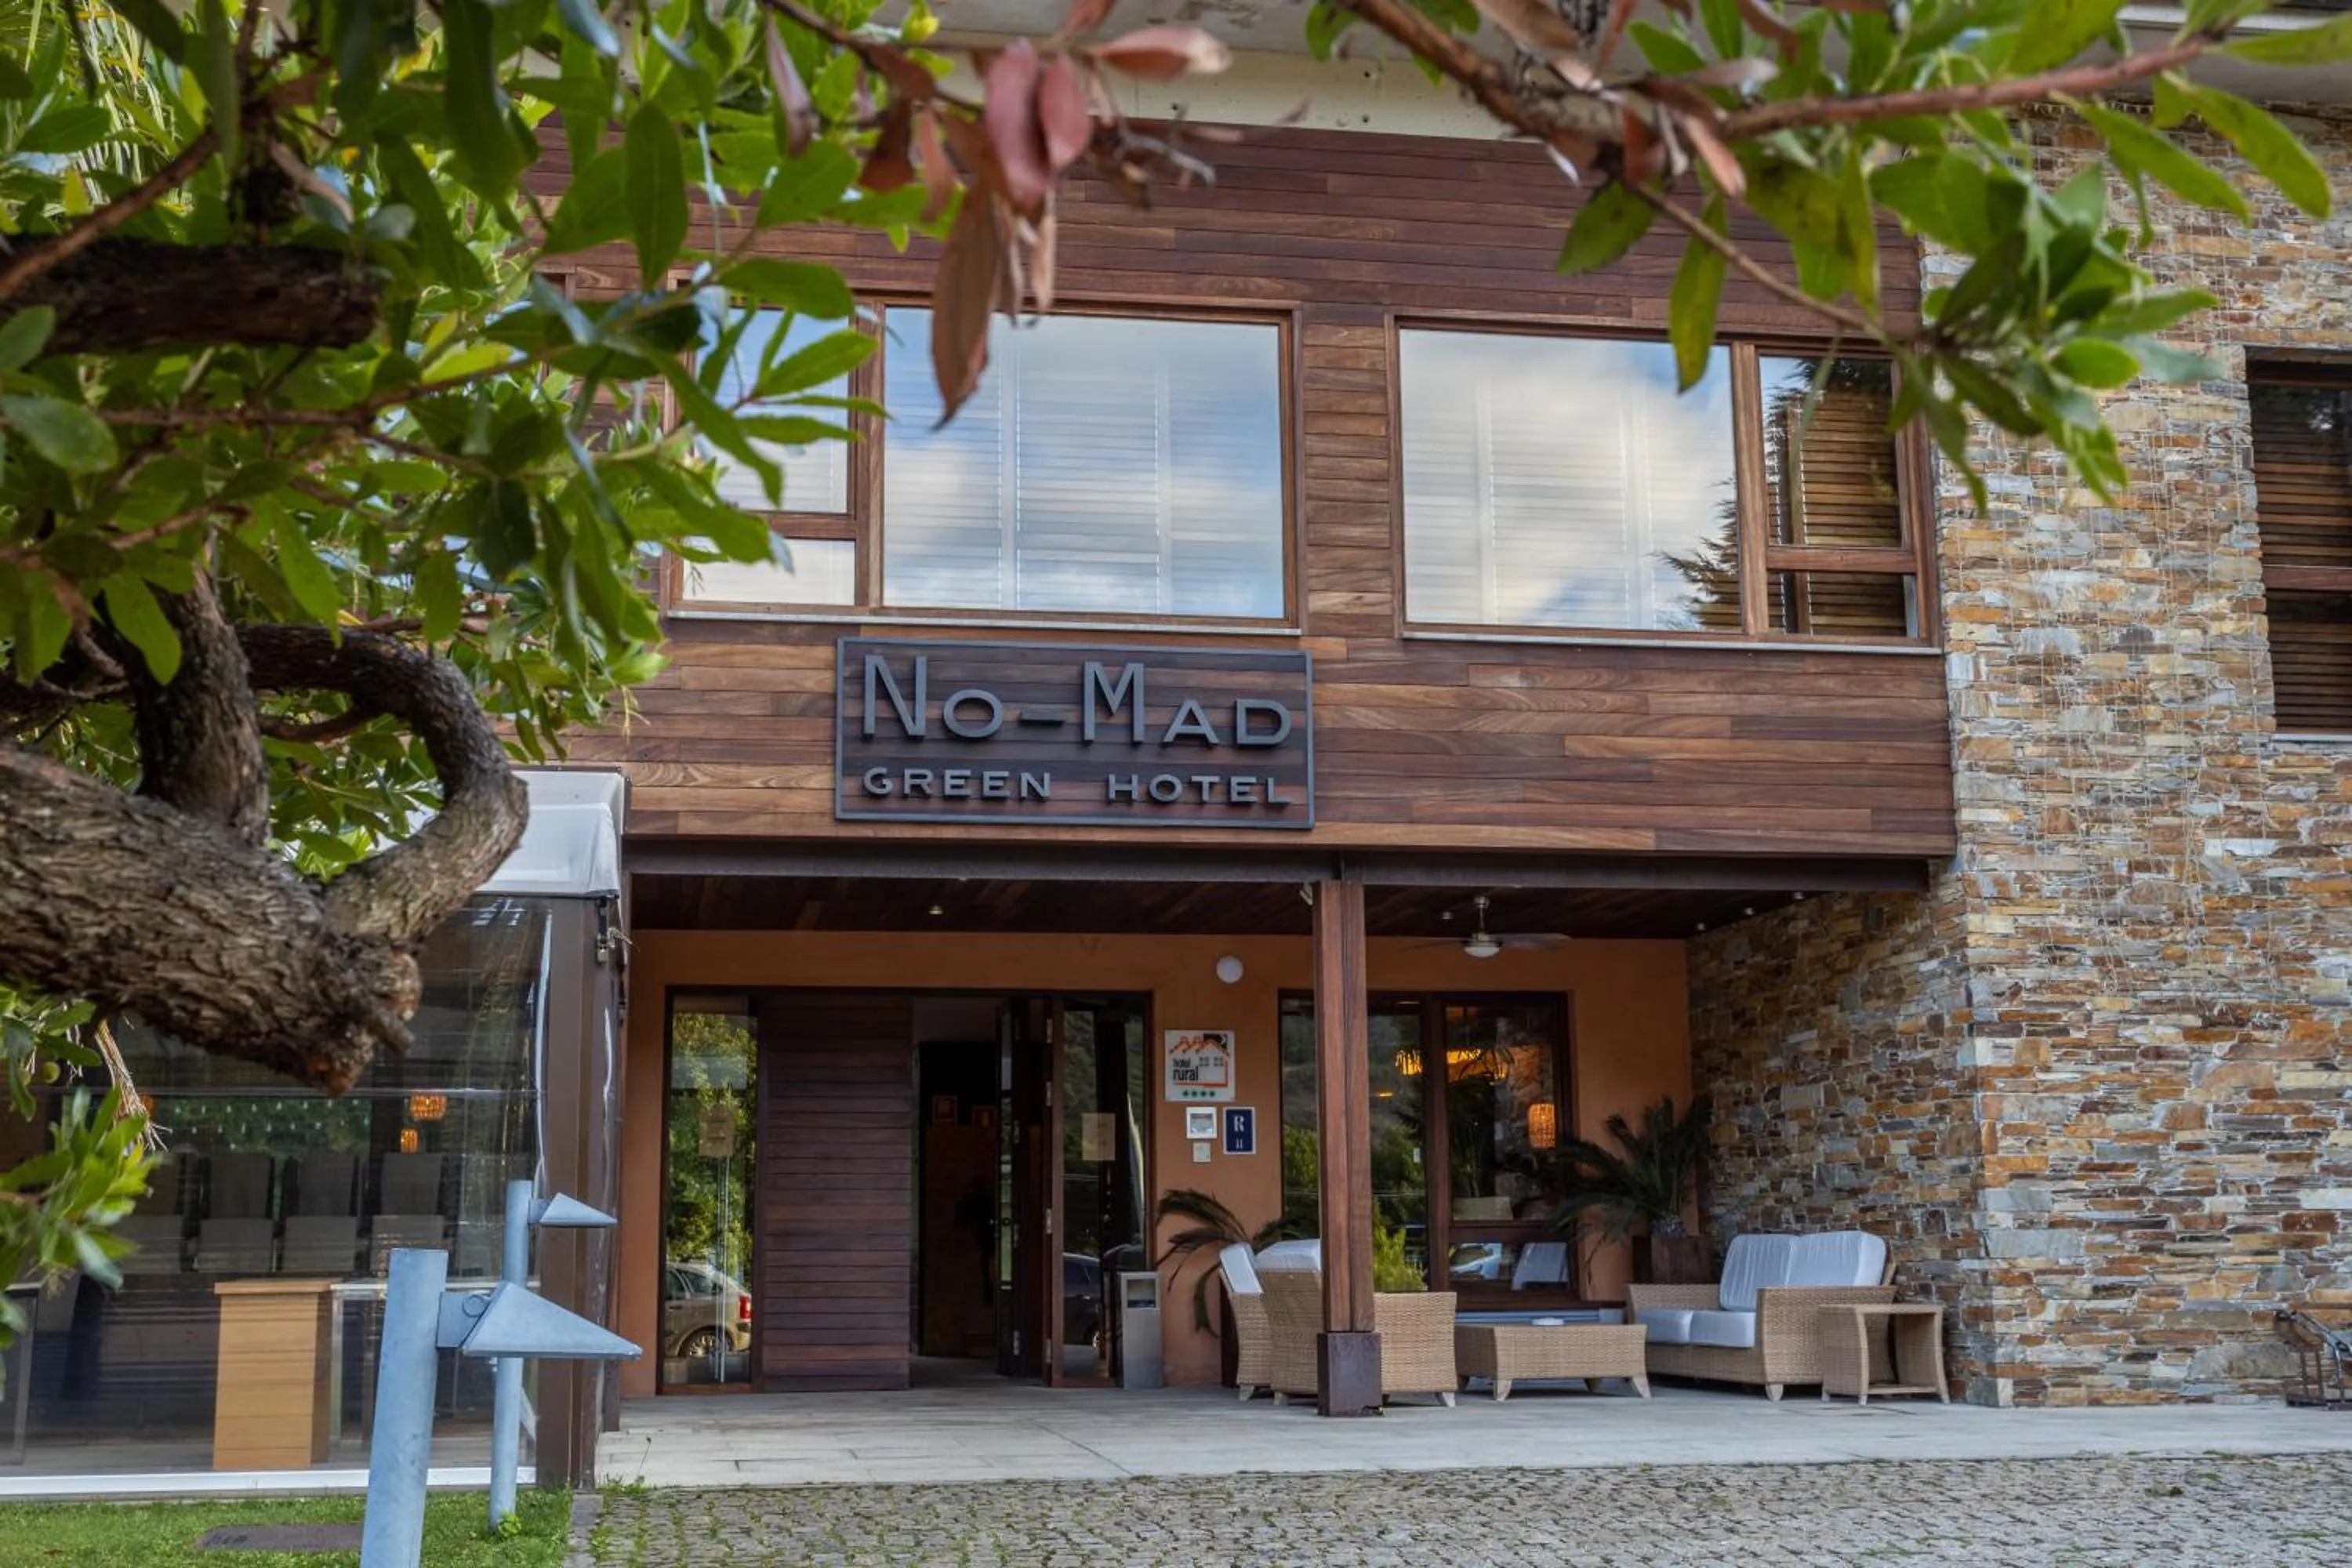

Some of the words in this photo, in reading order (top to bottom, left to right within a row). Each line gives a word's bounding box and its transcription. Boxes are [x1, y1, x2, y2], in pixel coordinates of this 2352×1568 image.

[862, 766, 1051, 801] GREEN
[1107, 773, 1293, 807] HOTEL
[1174, 1066, 1199, 1081] rural
[1233, 1116, 1245, 1132] R
